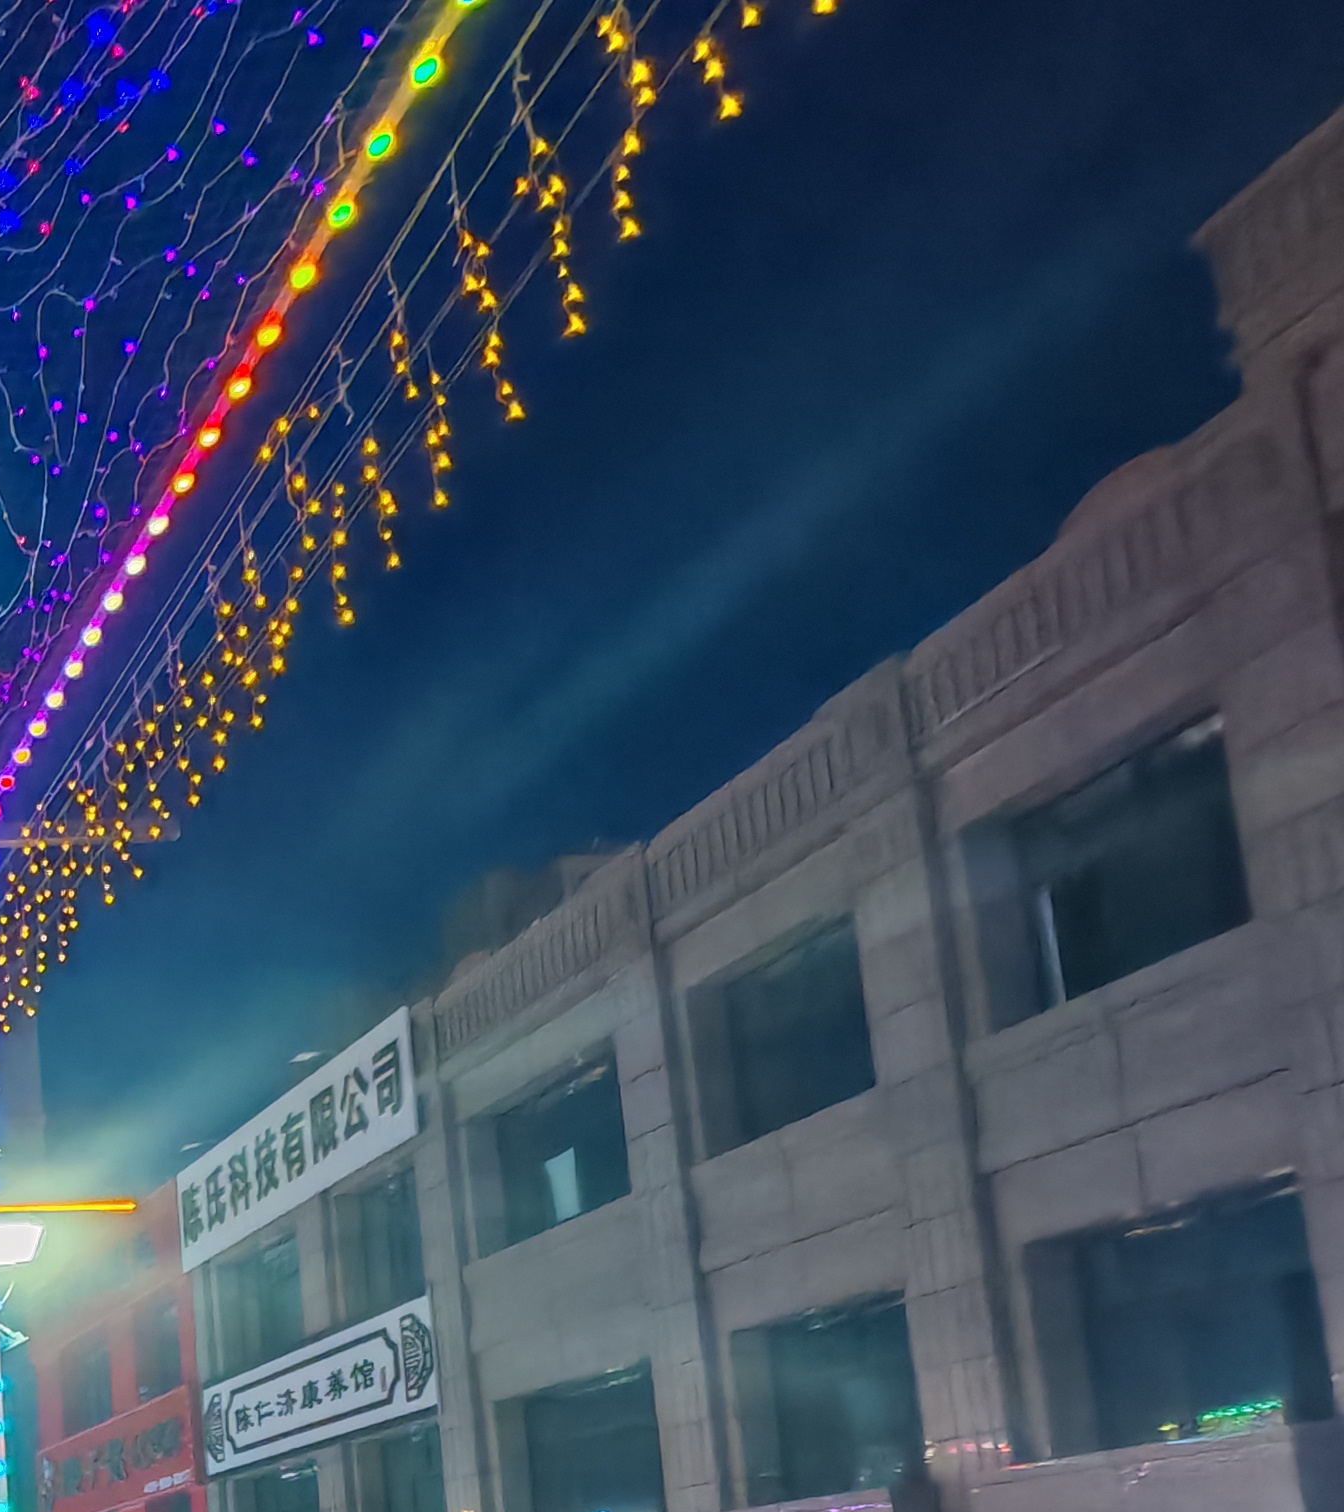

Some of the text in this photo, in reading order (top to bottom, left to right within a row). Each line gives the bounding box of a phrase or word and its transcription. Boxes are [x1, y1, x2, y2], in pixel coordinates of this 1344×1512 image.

[181, 1038, 403, 1248] 陈氏科技有限公司
